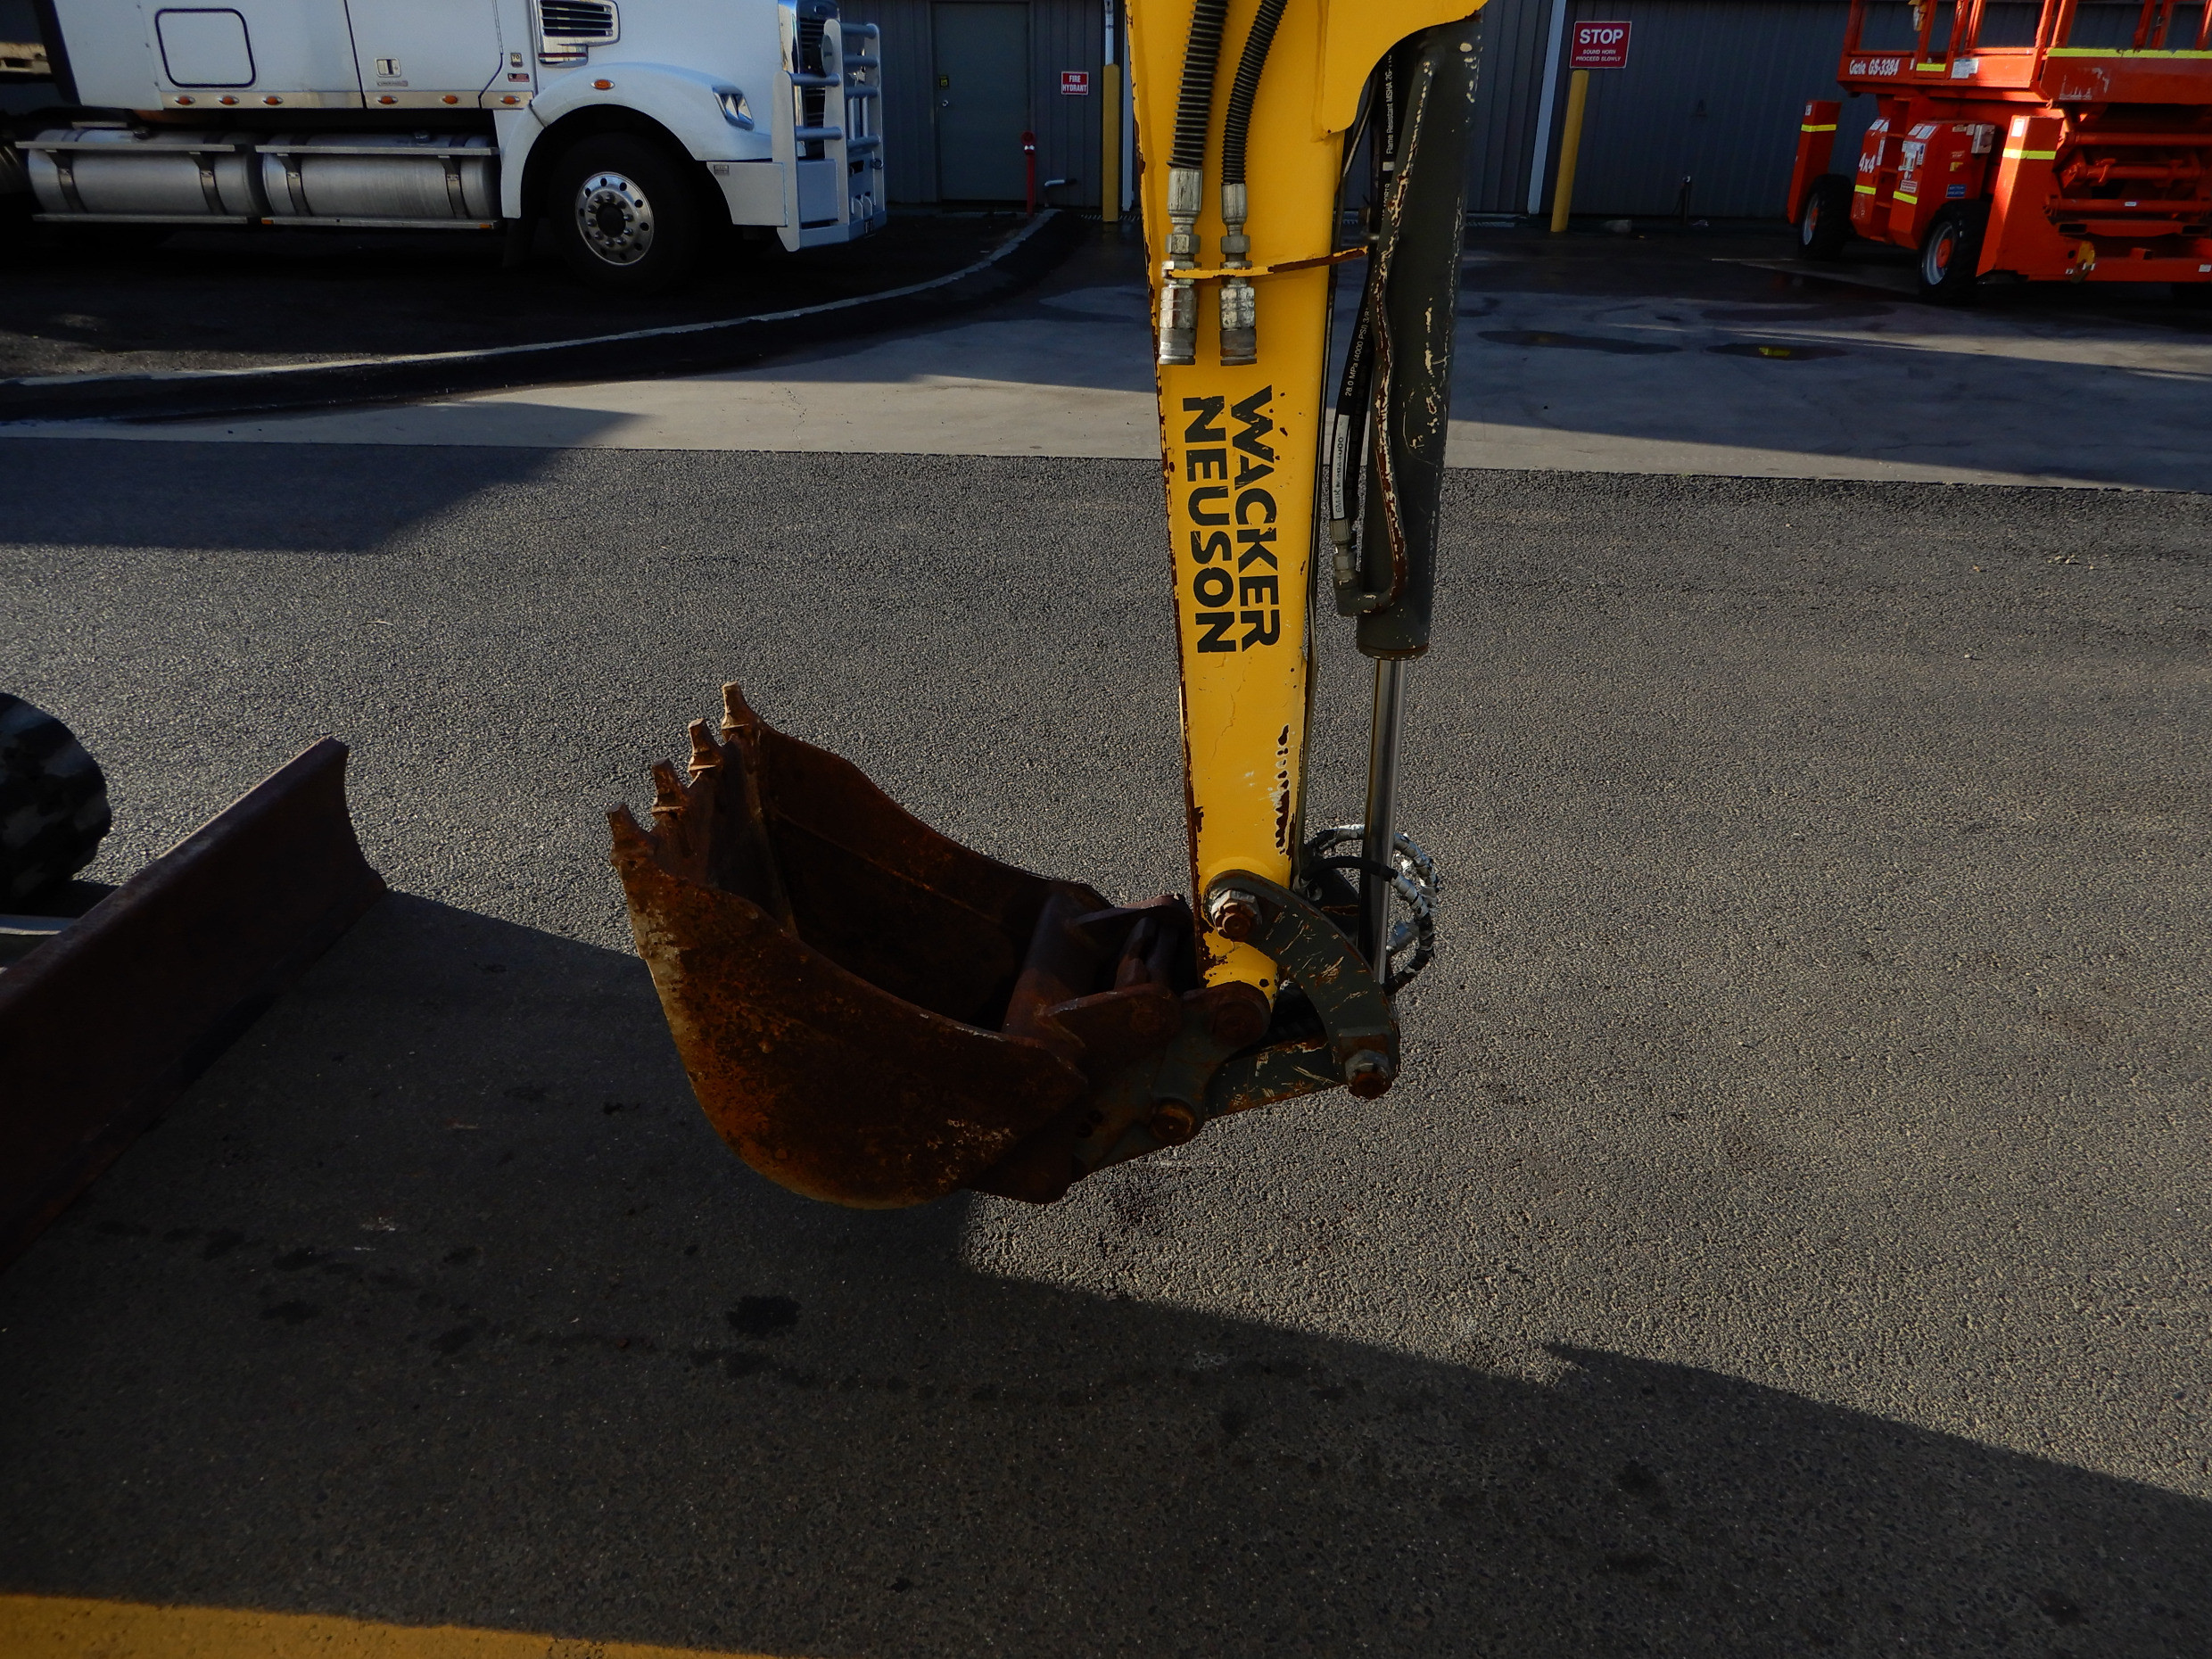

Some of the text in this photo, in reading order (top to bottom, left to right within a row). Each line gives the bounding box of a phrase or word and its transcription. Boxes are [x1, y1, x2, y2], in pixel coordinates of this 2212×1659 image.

[1580, 29, 1623, 44] STOP
[1849, 58, 1900, 76] Genie GS-3384
[1062, 84, 1087, 93] HYDRANT
[1069, 75, 1081, 83] FIRE
[1385, 82, 1393, 103] MSHA
[1385, 103, 1394, 134] Resistant
[1385, 134, 1394, 155] Flame
[1859, 153, 1876, 173] 4x4
[1358, 324, 1369, 340] PSI)
[1352, 341, 1365, 362] (4000
[1348, 362, 1359, 380] MPa
[1344, 380, 1355, 398] 28.0
[1182, 395, 1237, 654] NEUSON
[1230, 384, 1281, 653] WACKER
